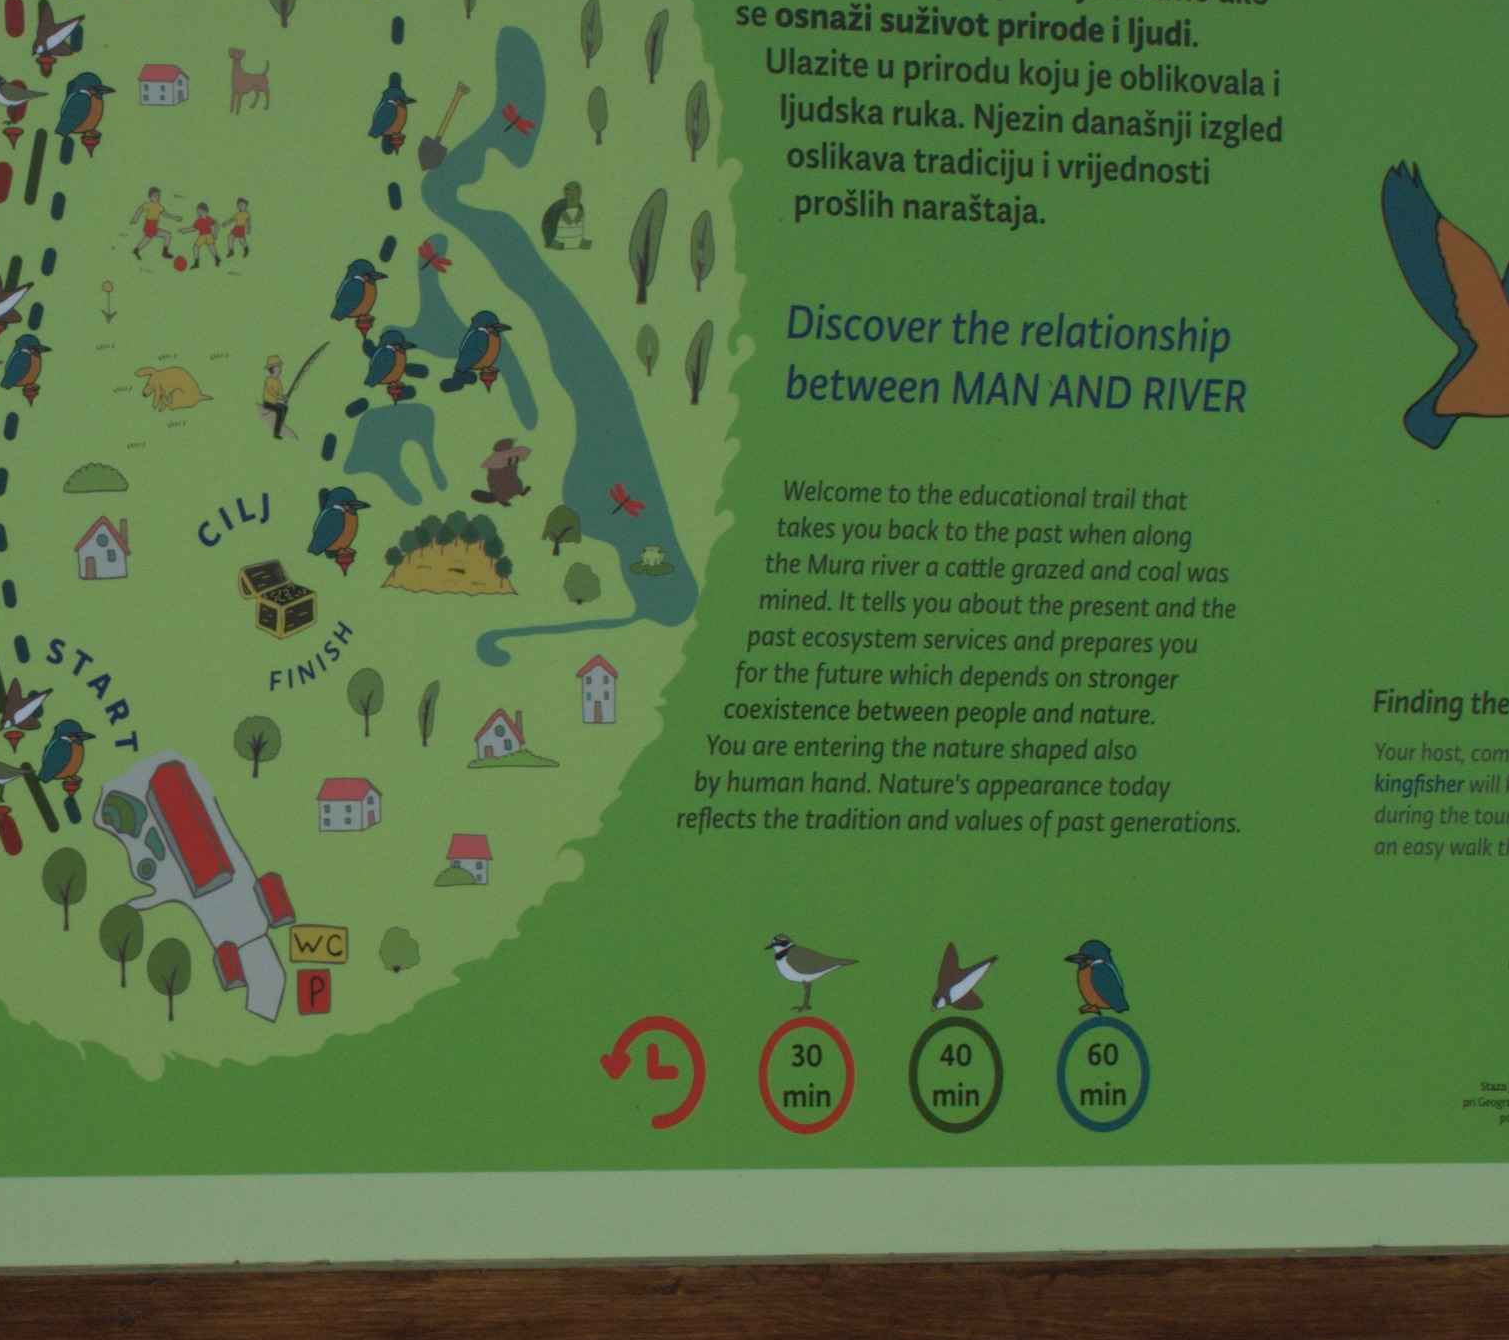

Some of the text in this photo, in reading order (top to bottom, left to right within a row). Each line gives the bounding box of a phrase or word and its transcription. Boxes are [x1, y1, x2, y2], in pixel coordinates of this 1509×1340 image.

[735, 1, 1199, 53] se osnaži suživot prirode i ljudi.
[779, 92, 1283, 149] ljudska ruka. Njezin današnji izgled
[786, 302, 1232, 363] Discover the relationship
[785, 363, 1247, 413] between MAN AND RIVER
[783, 478, 1189, 511] Welcome to the educational trail that
[197, 492, 270, 547] CILJ
[269, 620, 353, 692] FINISH
[746, 626, 1198, 660] past ecosystem services and prepares you
[46, 638, 139, 752] START
[1372, 687, 1465, 723] Finding
[723, 696, 1155, 729] coexistence between people and nature.
[1374, 741, 1416, 762] Your
[1420, 741, 1466, 765] host,
[693, 768, 1172, 803] by human hand. Nature's appearance today
[1373, 772, 1466, 799] kingfisher
[1469, 774, 1501, 794] will
[293, 933, 343, 957] WC
[310, 975, 326, 1008] P
[791, 1042, 823, 1068] 30
[939, 1042, 973, 1067] 40
[1086, 1042, 1120, 1067] 60
[782, 1082, 832, 1108] min
[932, 1081, 980, 1107] min
[1079, 1080, 1127, 1106] min
